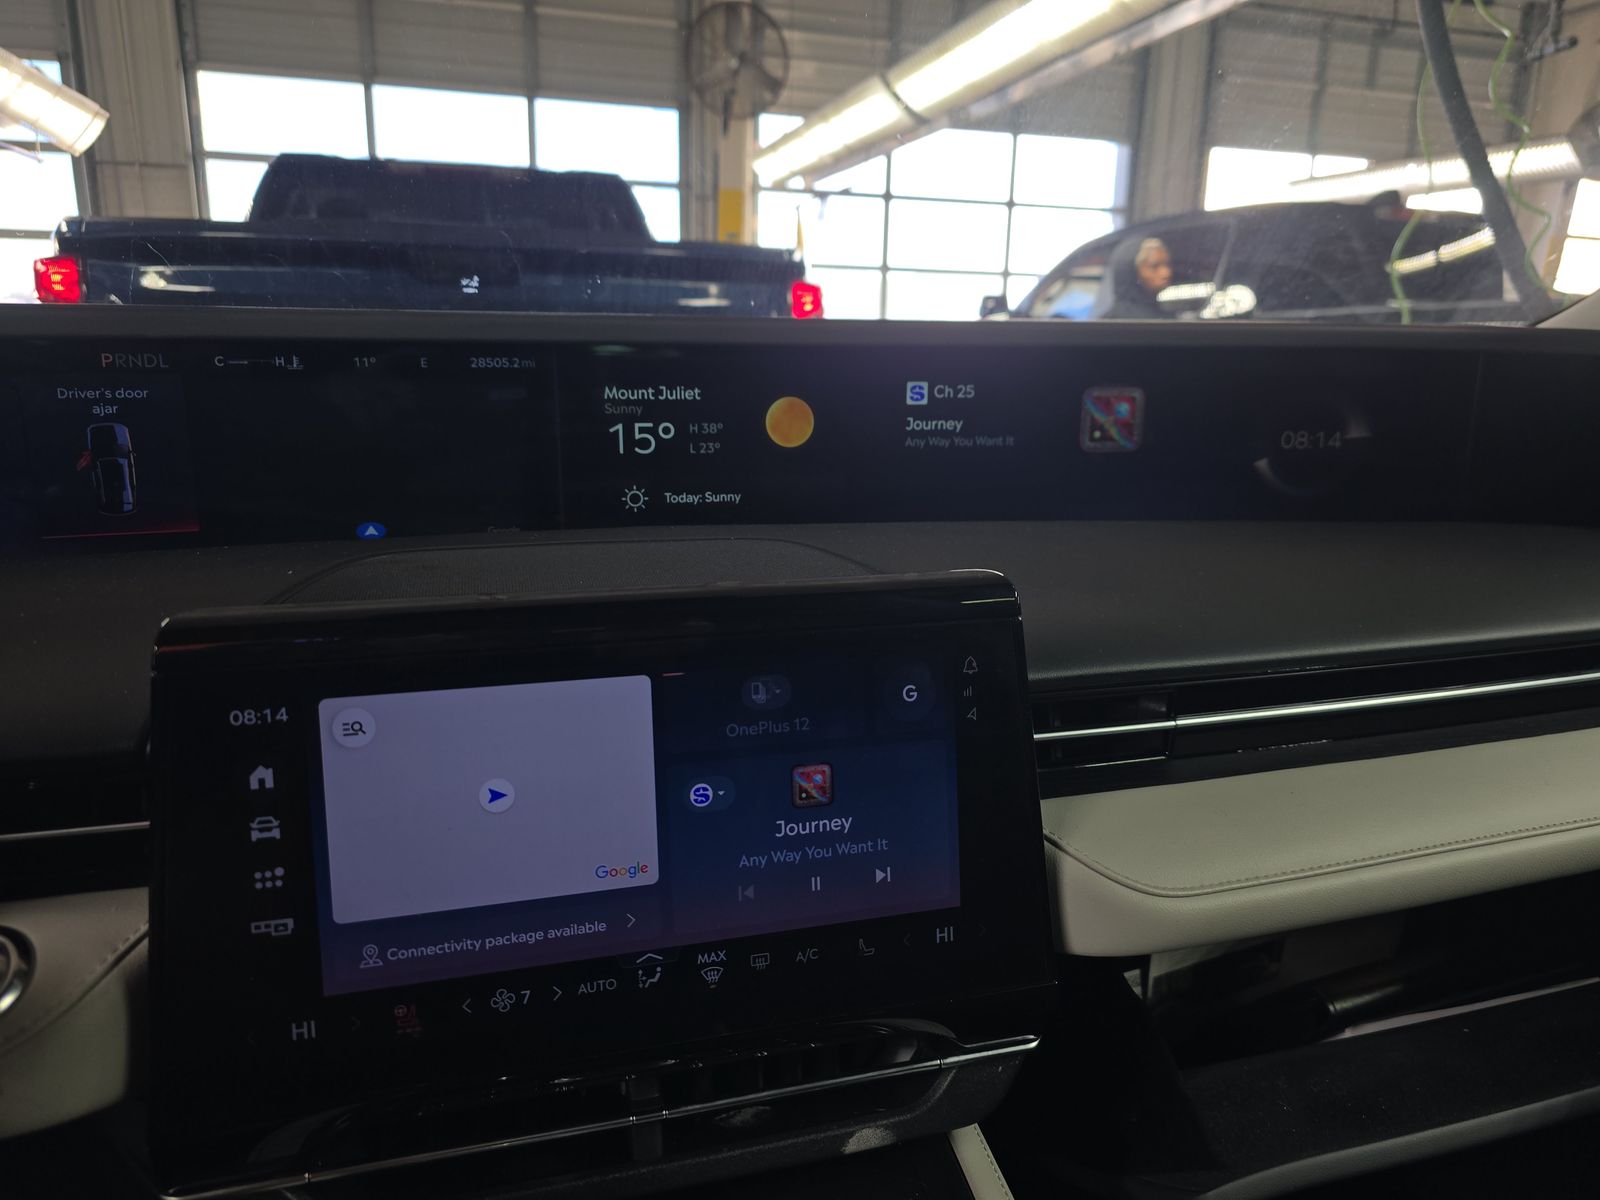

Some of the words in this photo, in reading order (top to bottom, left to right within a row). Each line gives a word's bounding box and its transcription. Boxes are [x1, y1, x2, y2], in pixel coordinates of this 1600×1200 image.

[420, 357, 428, 369] E
[57, 386, 112, 400] Driver's
[115, 387, 149, 399] door
[603, 385, 656, 400] Mount
[658, 385, 702, 400] Juliet
[934, 384, 954, 399] Ch
[956, 384, 976, 399] 25
[92, 402, 119, 417] ajar
[604, 402, 644, 416] Sunny
[689, 423, 700, 435] H
[701, 422, 724, 435] 38°
[905, 417, 964, 433] Journey
[608, 421, 676, 455] 15°
[905, 436, 926, 449] Any
[928, 436, 951, 449] Way
[953, 436, 973, 448] You
[975, 435, 1003, 447] Want
[1005, 435, 1015, 447] It
[1280, 430, 1343, 450] 08:14
[689, 442, 697, 454] L
[699, 442, 721, 454] 23°
[664, 491, 703, 505] Today:
[705, 490, 742, 505] Sunny
[228, 706, 289, 727] 08:14
[726, 718, 790, 738] OnePlus
[794, 717, 811, 732] 12
[775, 816, 853, 838] Journey
[738, 854, 767, 869] Any
[771, 849, 802, 865] Way
[804, 845, 832, 860] You
[835, 841, 874, 857] Want
[877, 837, 889, 852] It
[595, 861, 649, 880] Google
[386, 937, 482, 961] Connectivity
[485, 928, 544, 950] package
[546, 920, 607, 940] available
[936, 926, 955, 945] HI
[697, 949, 727, 966] MAX
[795, 947, 819, 965] A/C
[577, 977, 618, 996] AUTO
[520, 990, 532, 1006] 7
[290, 1019, 317, 1042] HI
